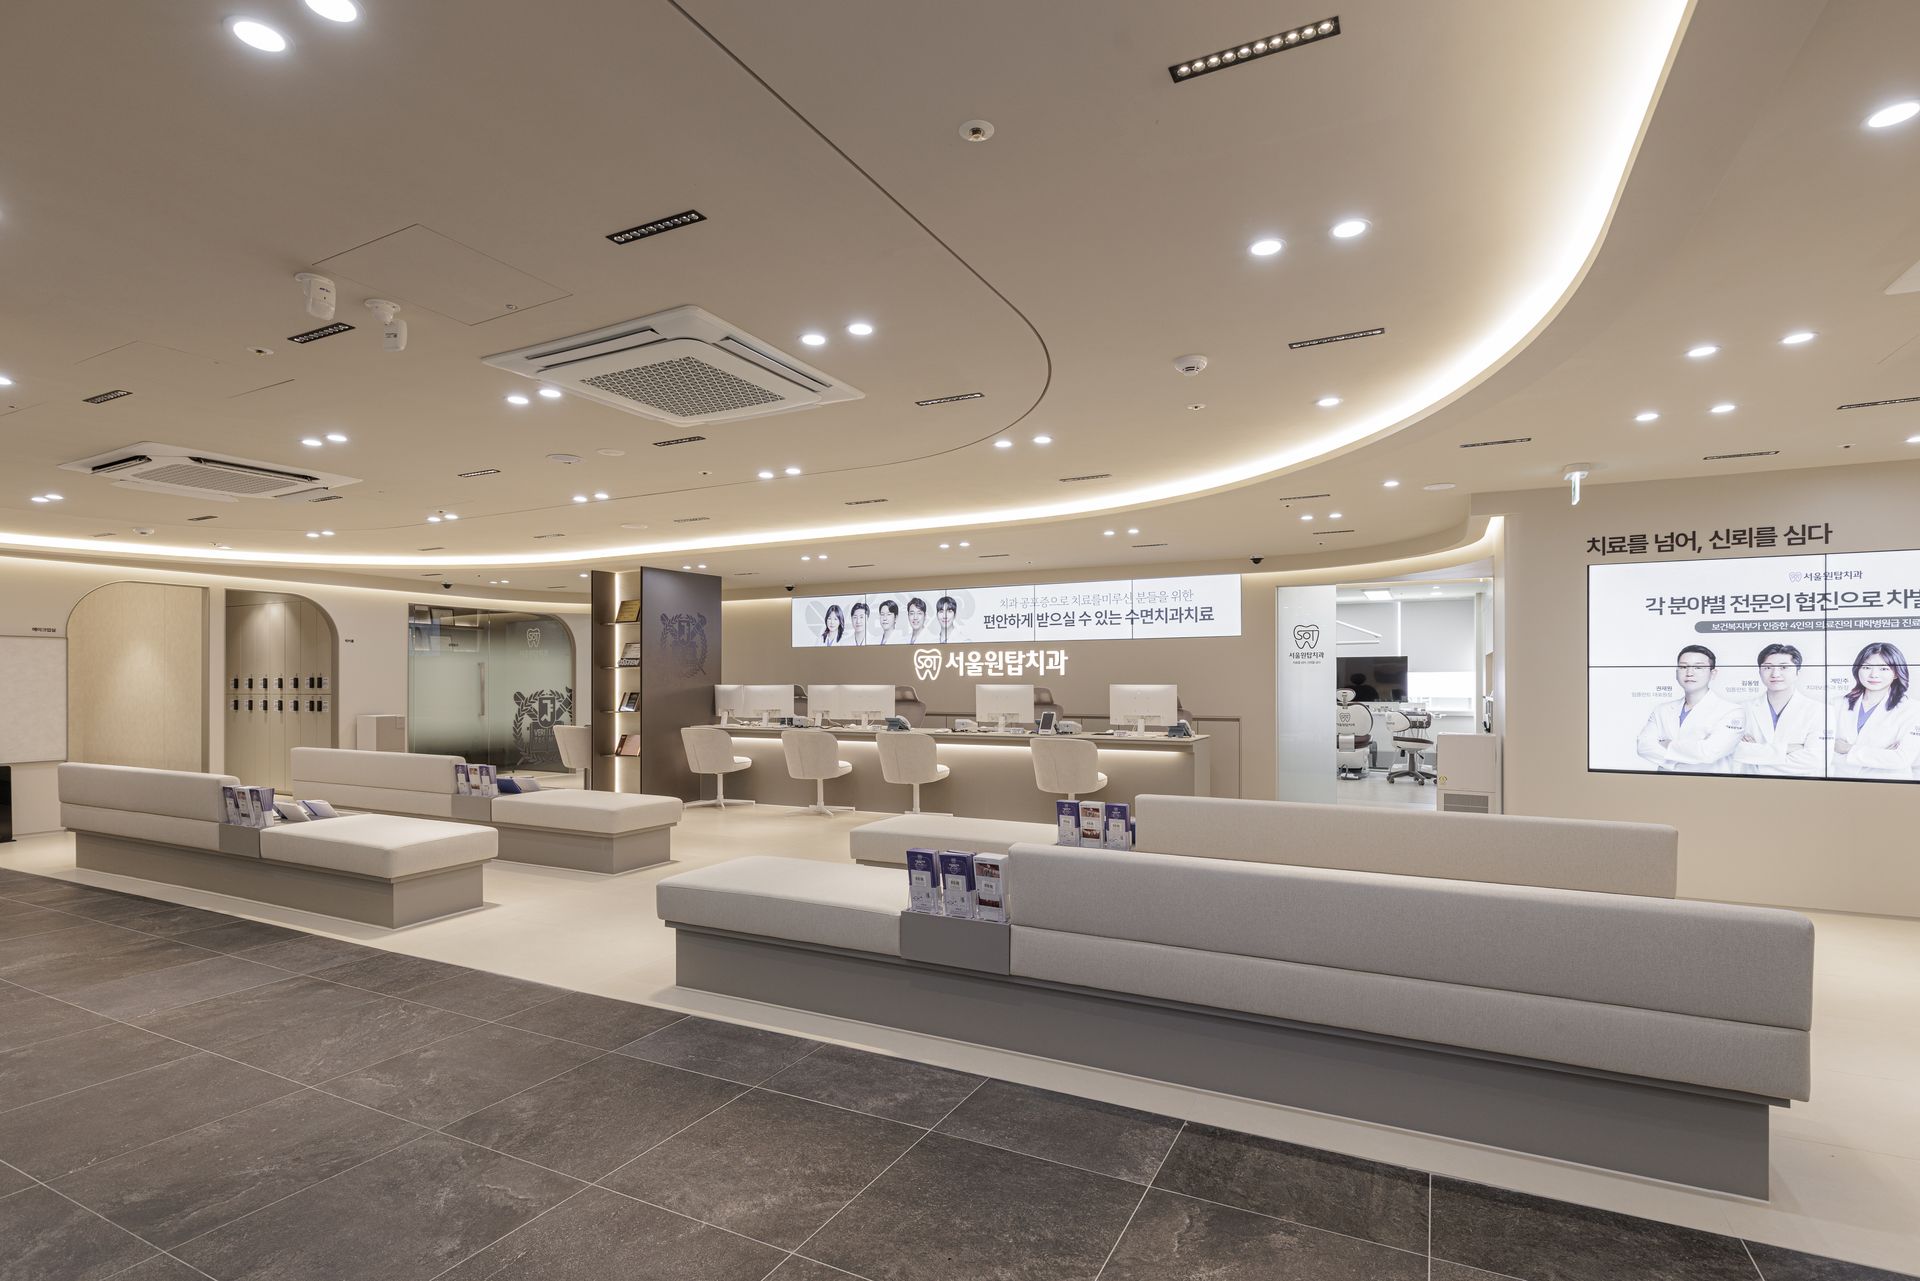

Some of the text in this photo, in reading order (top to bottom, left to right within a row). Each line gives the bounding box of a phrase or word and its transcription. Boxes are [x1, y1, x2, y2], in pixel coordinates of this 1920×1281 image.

[1586, 522, 1833, 556] 치료를 넘어, 신뢰를 심다
[1803, 570, 1863, 582] 서울원탑치과
[1000, 596, 1018, 609] 치과
[1019, 594, 1070, 608] 공포증으로
[1136, 589, 1169, 604] 분들을
[1170, 588, 1194, 603] 위한
[1645, 596, 1664, 616] 각
[1668, 594, 1727, 615] 분야별
[1730, 592, 1791, 614] 전문의
[1795, 590, 1883, 613] 협진으로
[983, 605, 1215, 630] 편안하게 받으실 수 있는 수면치과치료
[1711, 621, 1761, 632] 보건복지부가
[1763, 621, 1788, 631] 인증한
[1790, 620, 1814, 630] 4인의
[1815, 619, 1853, 630] 의료진의
[1854, 618, 1900, 629] 대학병원급
[945, 649, 1069, 677] 서울원탑치과
